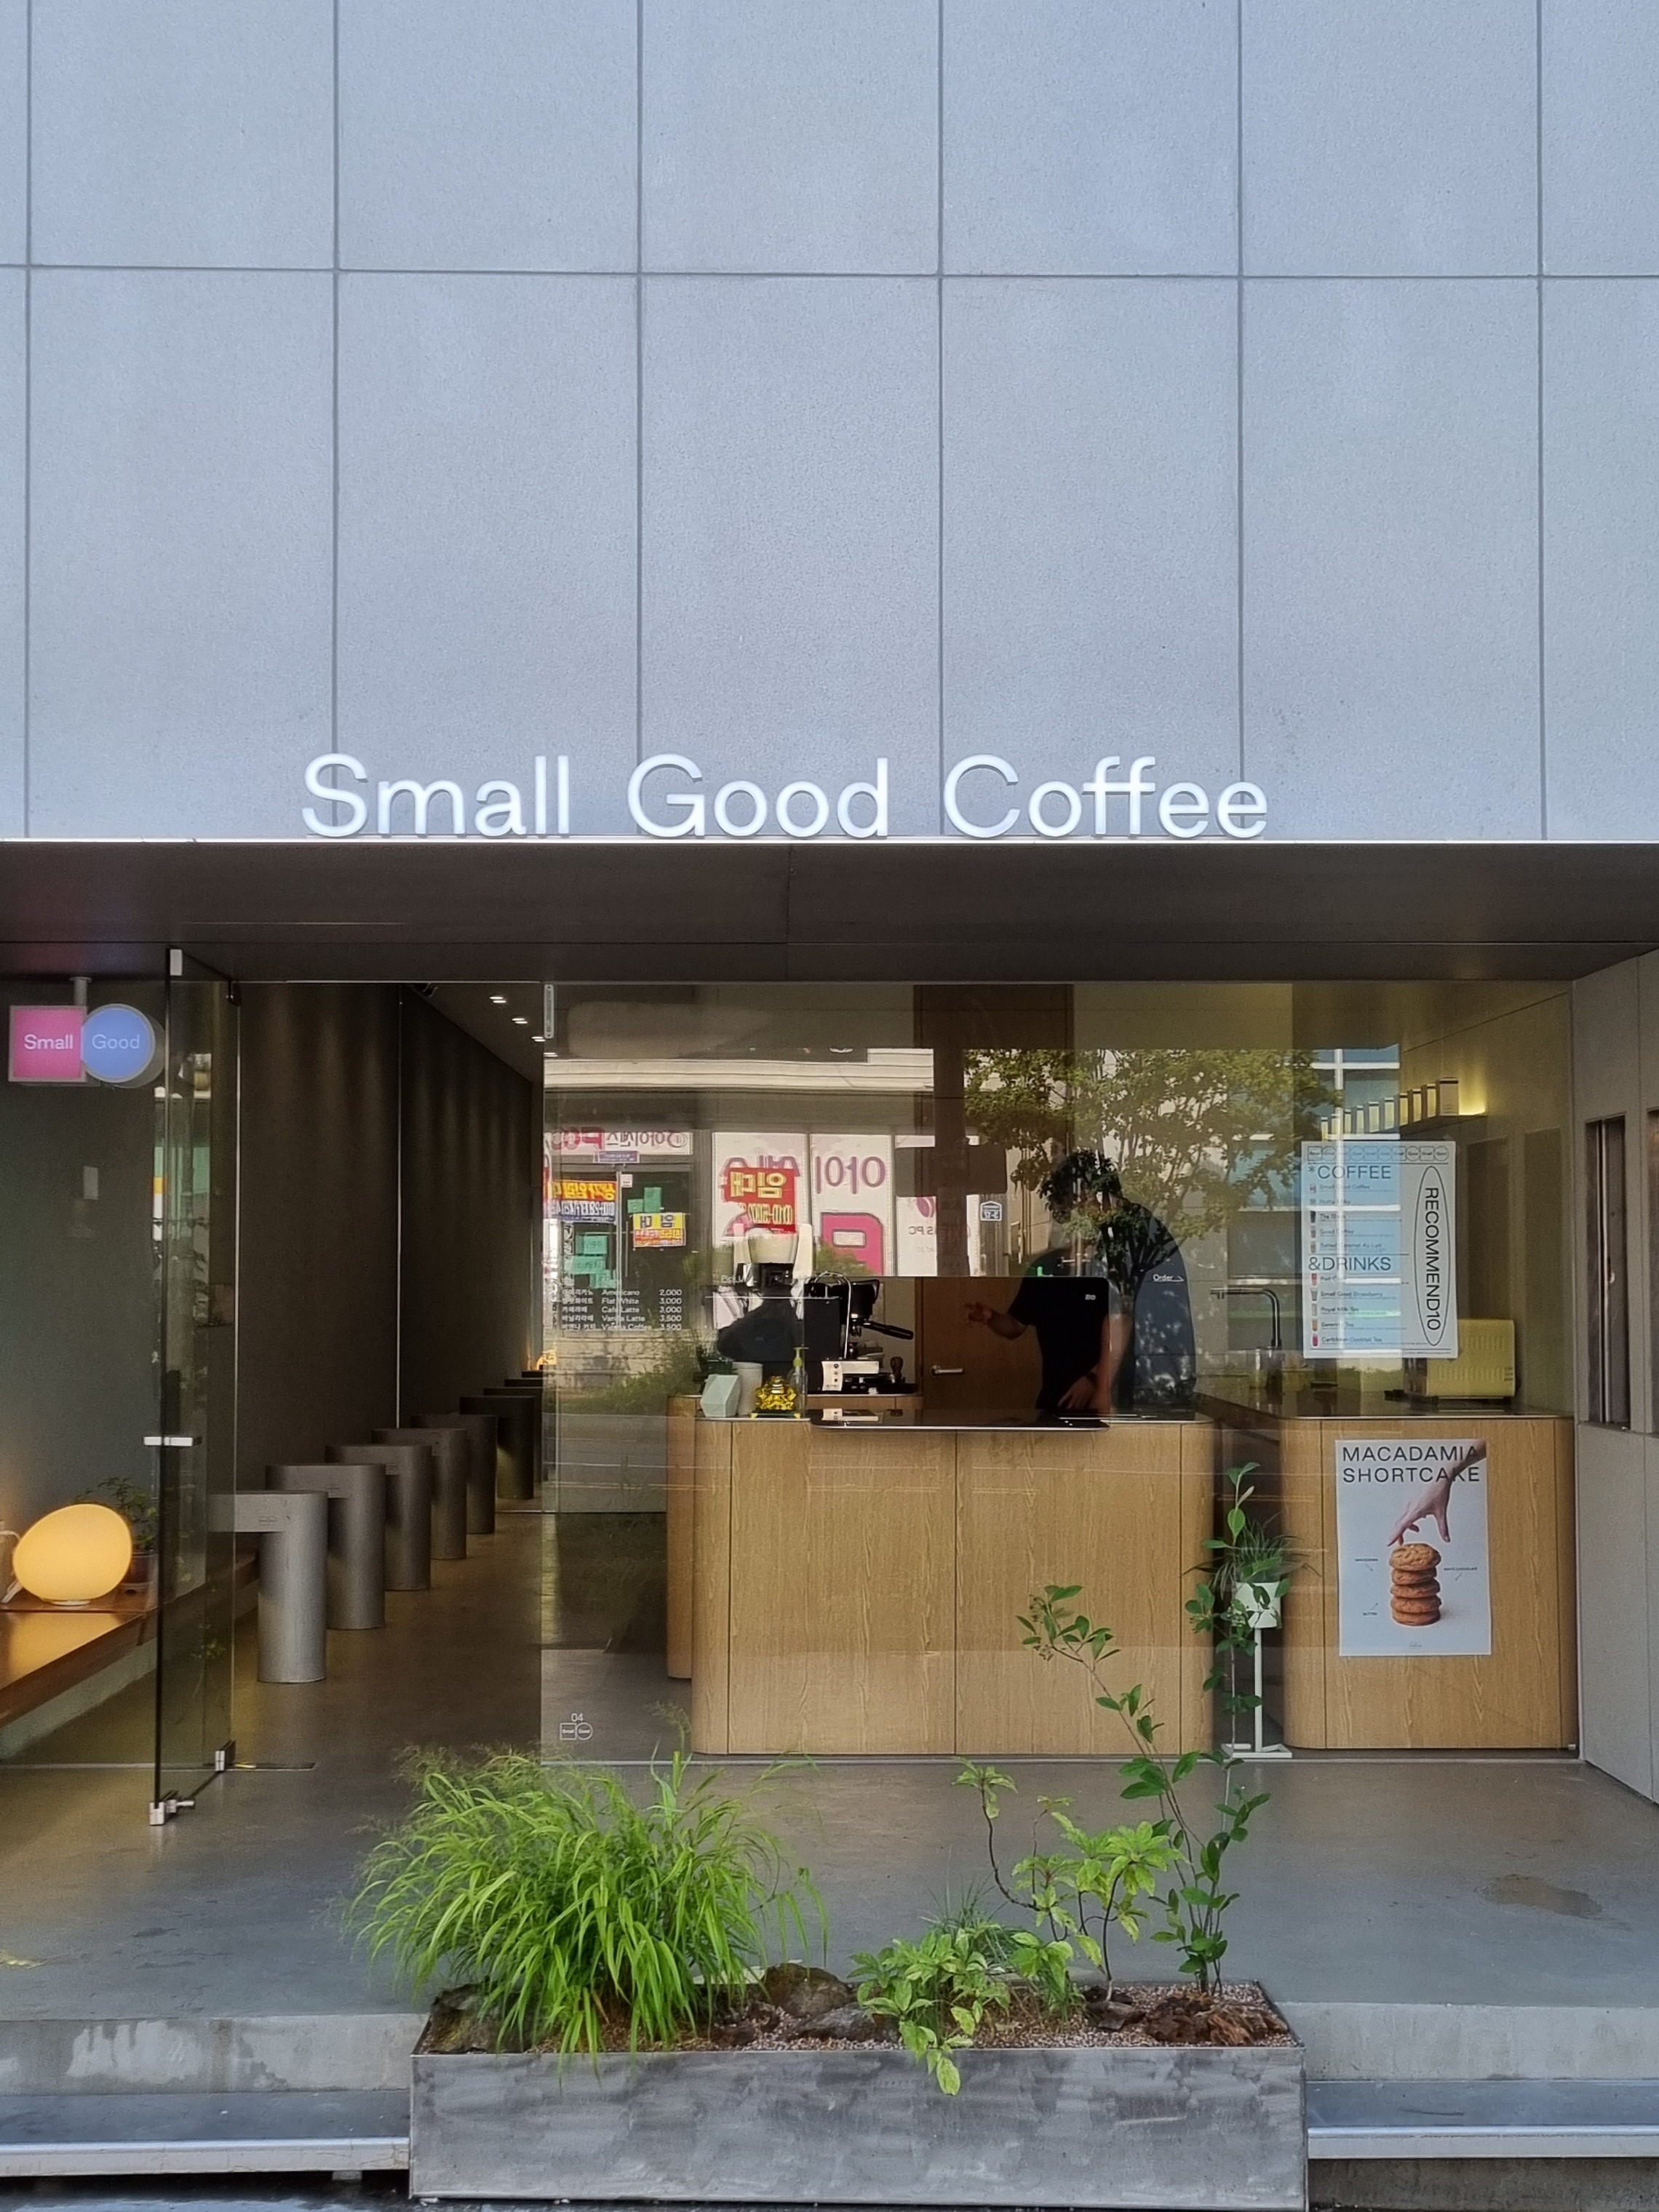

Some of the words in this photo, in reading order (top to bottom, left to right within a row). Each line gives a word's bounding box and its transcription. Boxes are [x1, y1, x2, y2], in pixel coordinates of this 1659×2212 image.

[302, 753, 570, 837] Small
[628, 754, 888, 837] Good
[944, 754, 1268, 838] Coffee
[24, 1034, 73, 1049] Small
[92, 1034, 140, 1049] Good
[1318, 1166, 1391, 1179] COFFEE
[1308, 1256, 1392, 1271] &DRINKS
[1424, 1187, 1441, 1331] RECOMMEND10
[1153, 1273, 1174, 1281] Order
[1342, 1445, 1479, 1462] MACADAMIA
[1343, 1466, 1480, 1483] SHORTCAKE
[570, 1712, 584, 1722] 04
